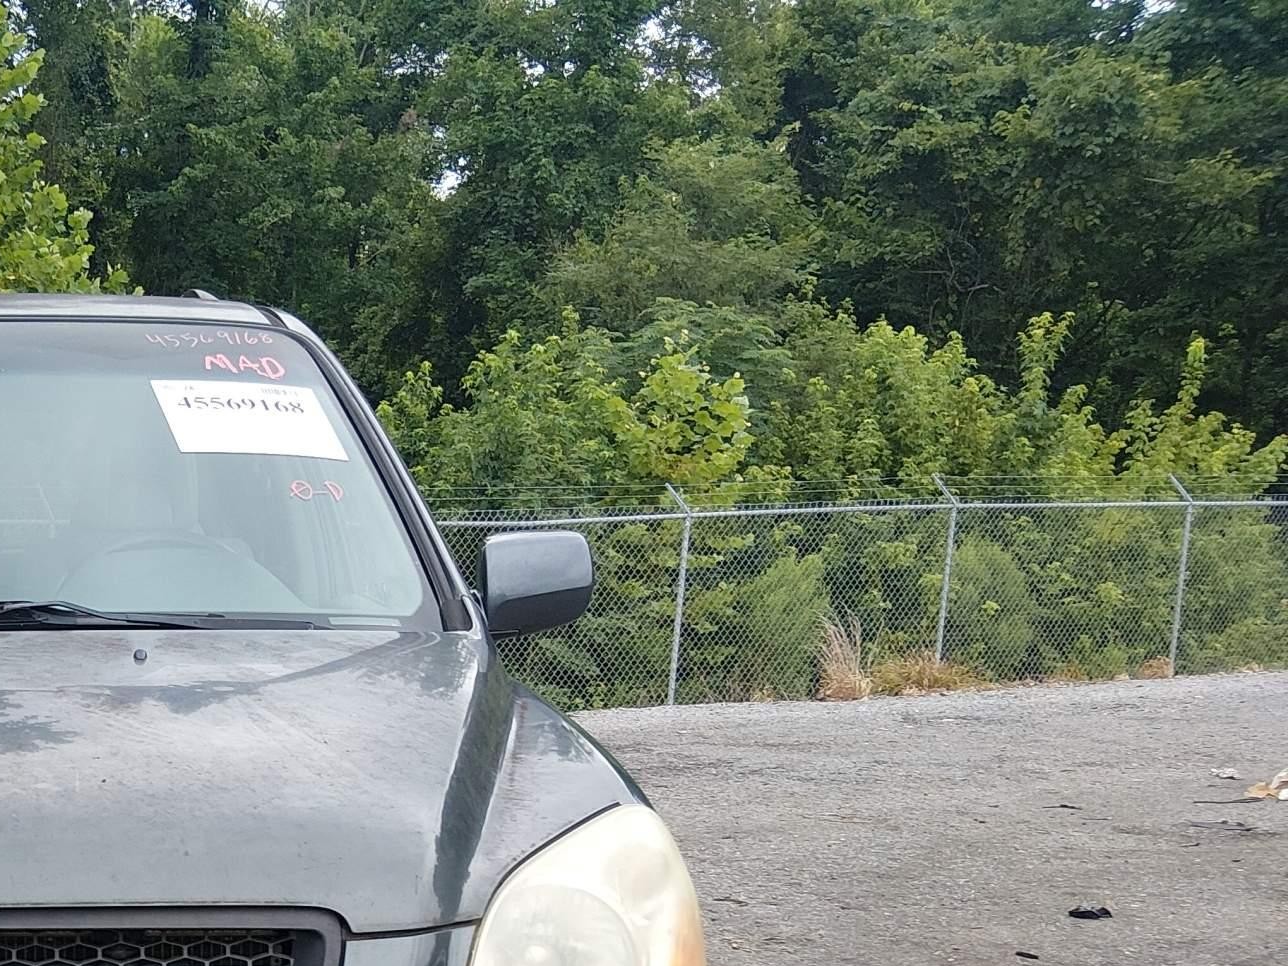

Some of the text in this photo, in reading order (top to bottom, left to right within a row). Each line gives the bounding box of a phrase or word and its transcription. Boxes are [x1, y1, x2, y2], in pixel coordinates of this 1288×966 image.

[146, 331, 273, 347] 45569168
[205, 354, 285, 379] MAD
[178, 396, 305, 414] 45569168
